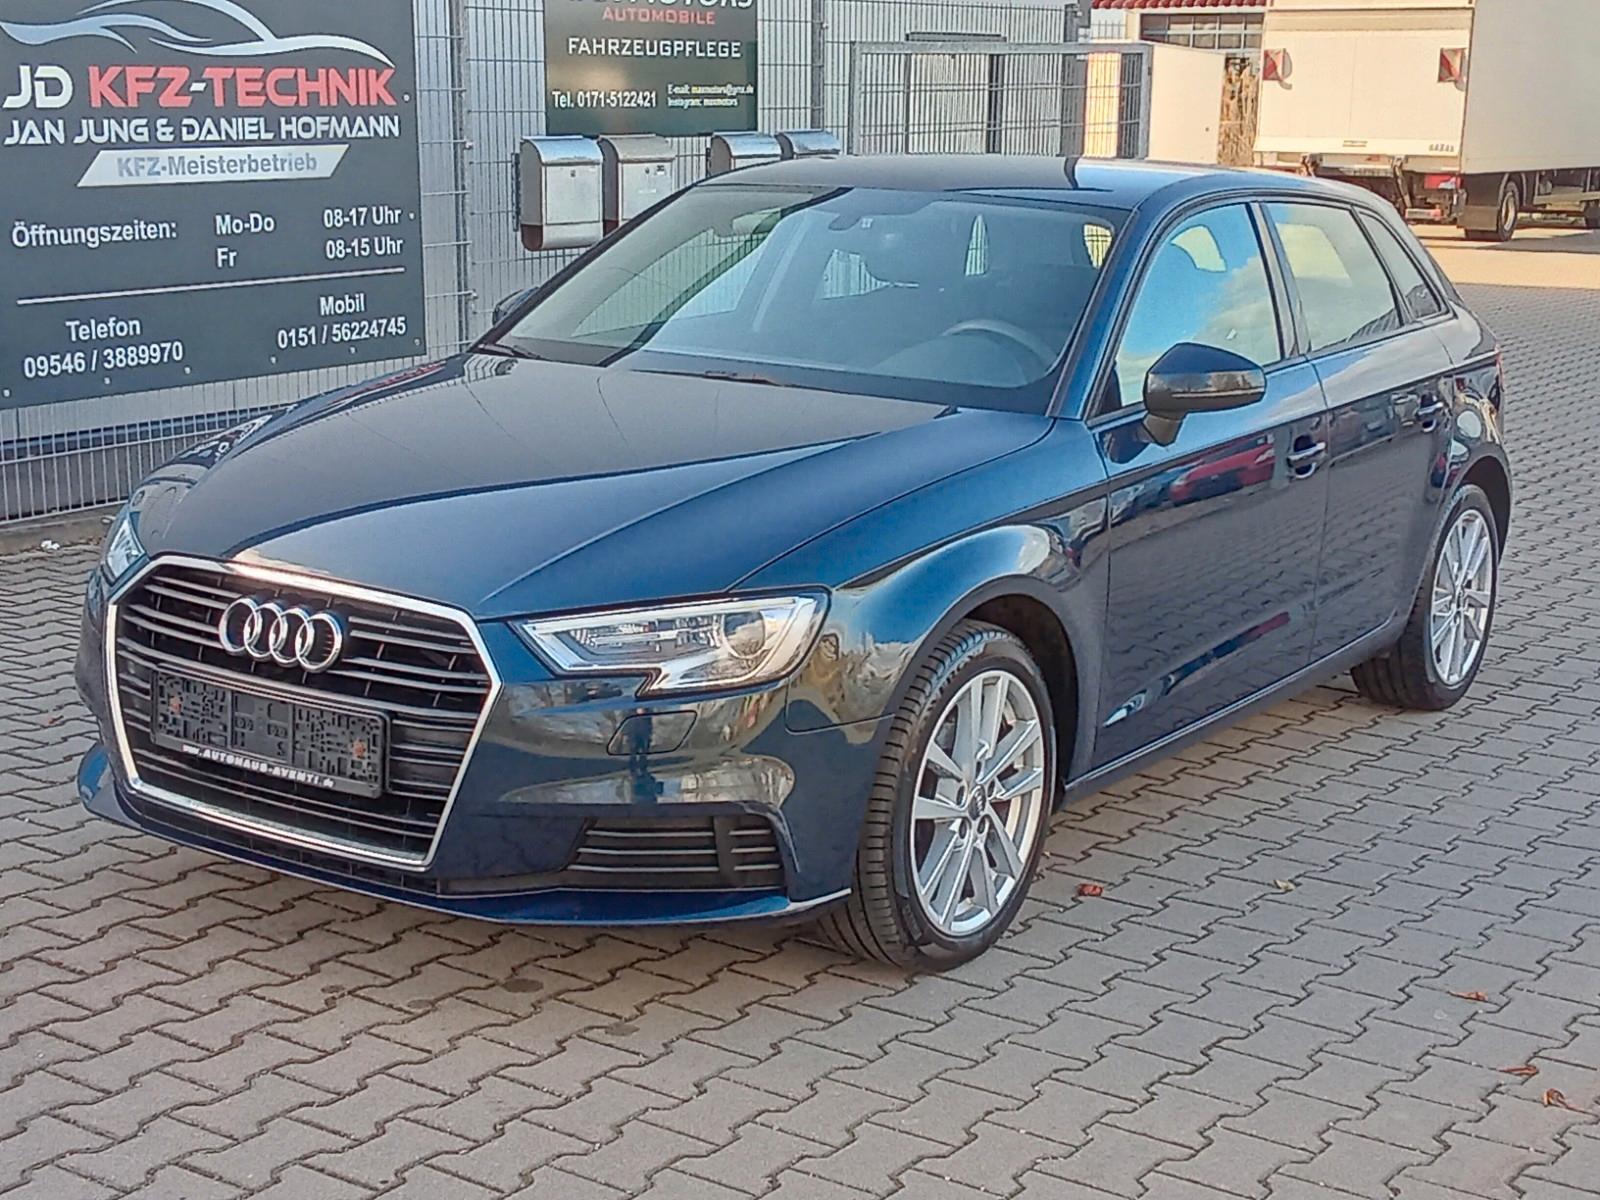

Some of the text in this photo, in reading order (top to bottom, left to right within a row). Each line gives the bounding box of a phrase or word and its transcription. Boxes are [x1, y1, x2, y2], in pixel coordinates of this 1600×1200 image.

[602, 7, 715, 25] AUTOMOBILE
[568, 38, 741, 57] FAHRZEUGPFLEGE
[3, 65, 397, 108] JD KFZ-TECHNIK
[552, 91, 574, 108] Tel.
[577, 91, 657, 108] 0171-5122421
[4, 115, 400, 146] JAN JUNG & DANIEL HOFMANN
[117, 152, 318, 178] KFZ-Meisterbetrieb
[11, 206, 402, 248] Öffnungszeiten: Mo-Do 08-17 Uhr
[217, 237, 403, 268] Fr 08-15 Uhr
[319, 293, 365, 316] Mobil
[65, 316, 141, 342] Telefon
[277, 316, 406, 349] 0151 / 56224745
[24, 341, 184, 378] 09546 / 3889970
